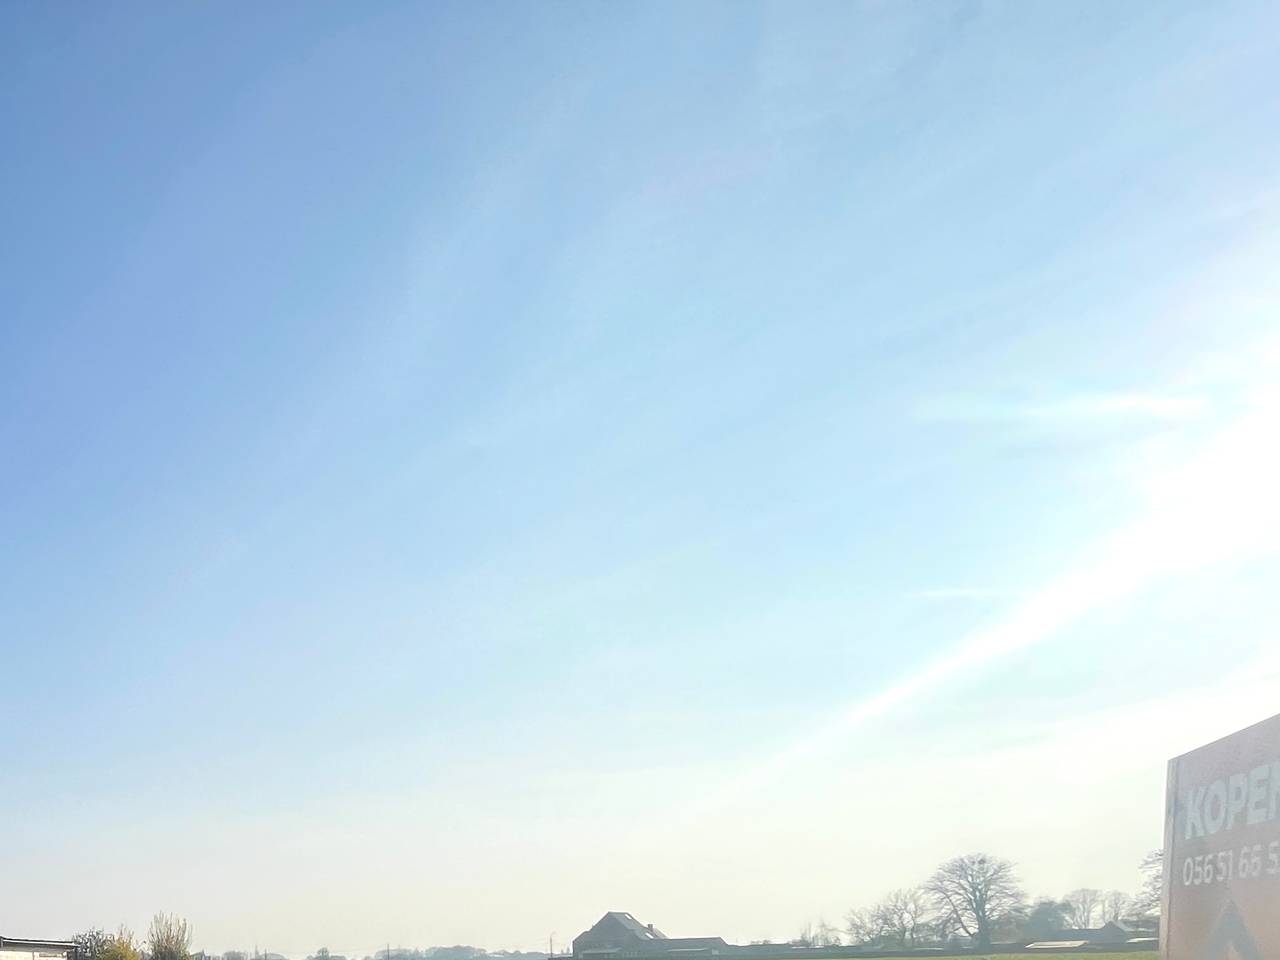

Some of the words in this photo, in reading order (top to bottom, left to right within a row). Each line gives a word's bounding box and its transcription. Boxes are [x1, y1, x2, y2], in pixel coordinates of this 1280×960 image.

[1183, 853, 1213, 886] 056
[1215, 849, 1233, 881] 51
[1238, 843, 1261, 879] 66
